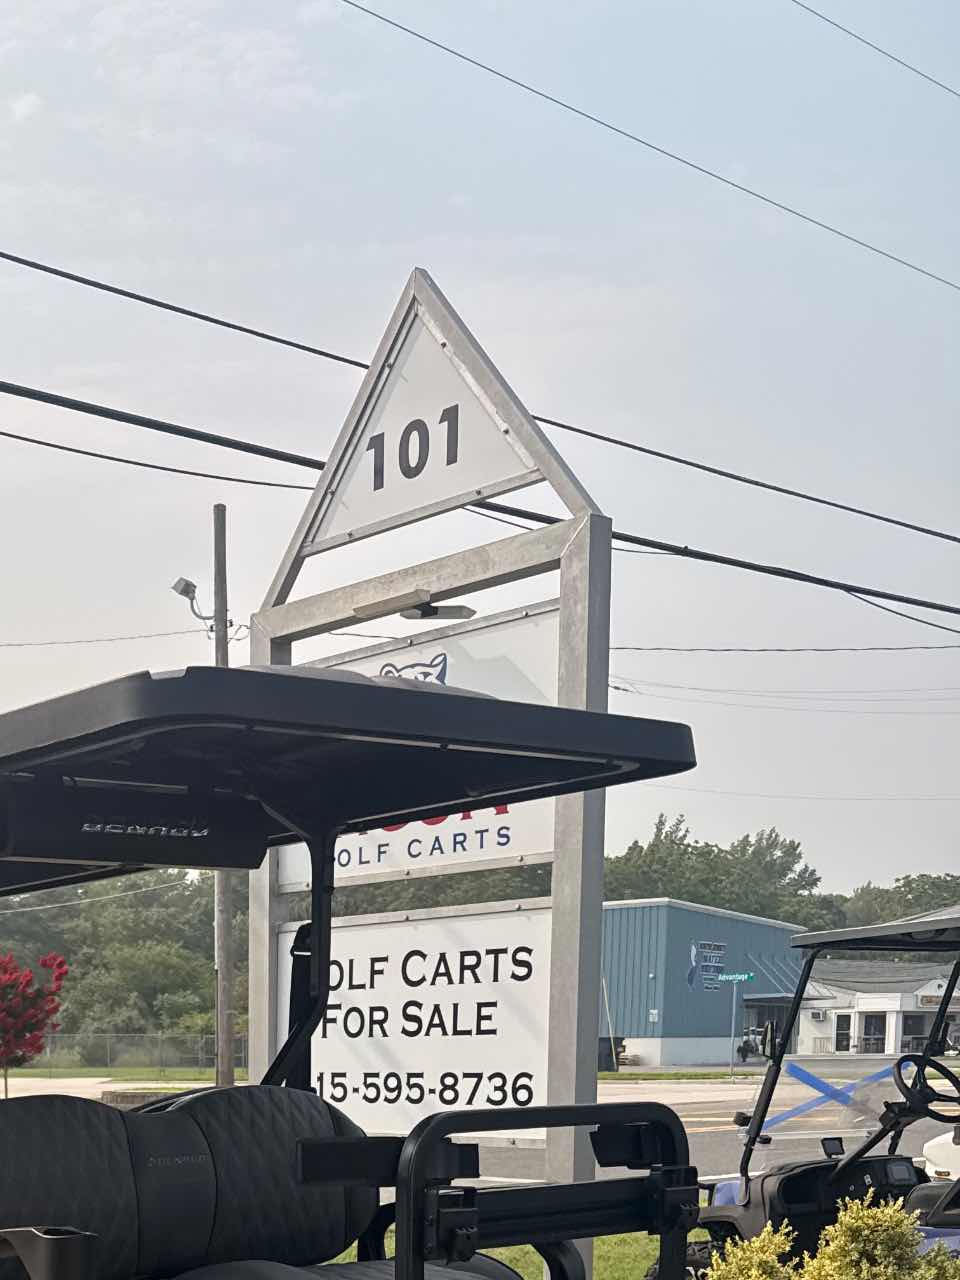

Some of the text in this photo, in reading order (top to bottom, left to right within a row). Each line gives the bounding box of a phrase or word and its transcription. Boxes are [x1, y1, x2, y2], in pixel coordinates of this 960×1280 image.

[366, 404, 460, 491] 101
[334, 826, 511, 867] OLF CARTS
[328, 947, 534, 991] OLF CARTS
[321, 1000, 498, 1039] FOR SALE
[317, 1071, 535, 1106] 15-595-8736
